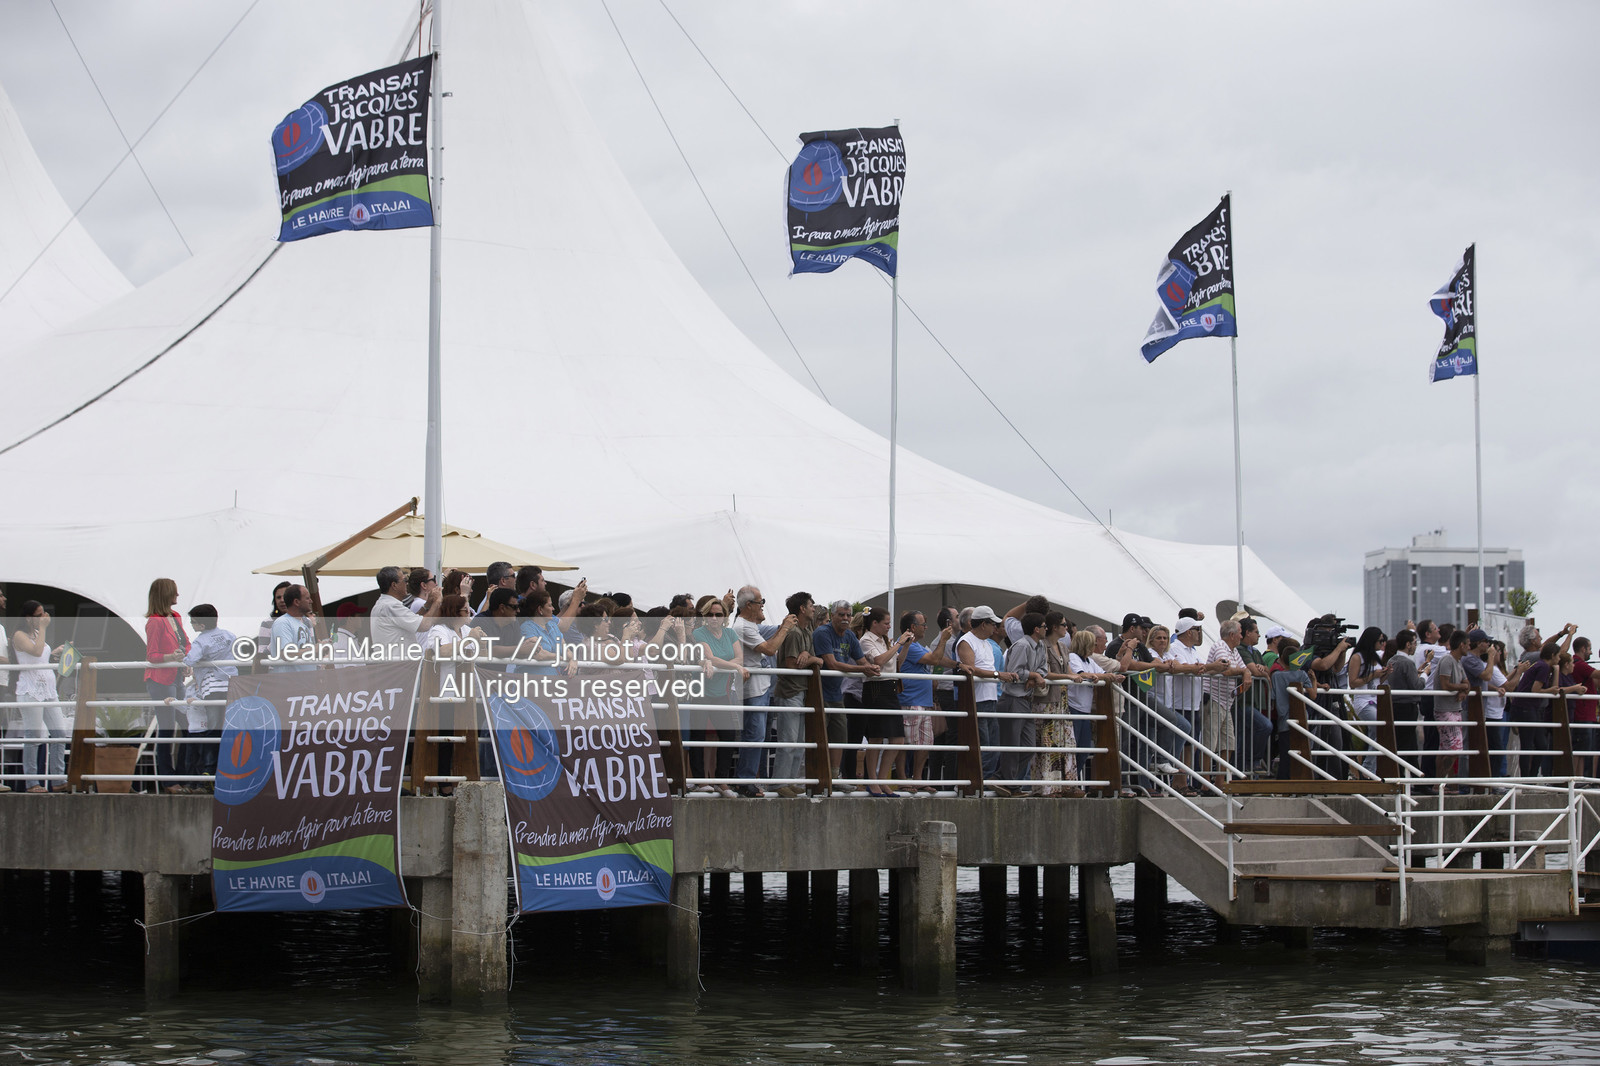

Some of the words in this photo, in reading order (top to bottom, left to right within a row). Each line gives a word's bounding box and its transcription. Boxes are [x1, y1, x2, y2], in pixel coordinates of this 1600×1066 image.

[323, 70, 424, 104] TRANSAT
[319, 112, 423, 156] VABRE
[290, 186, 313, 207] para
[314, 181, 323, 193] o
[390, 159, 399, 171] a
[399, 150, 425, 169] terra
[840, 176, 903, 208] VABR
[291, 216, 307, 230] LE
[308, 206, 345, 224] HAVRE
[370, 199, 411, 214] ITAJAI
[792, 225, 809, 239] Ir
[807, 230, 832, 243] para
[833, 229, 842, 240] o
[1187, 288, 1207, 308] Agir
[286, 687, 403, 718] TRANSAT
[551, 697, 645, 721] TRANSAT
[270, 746, 395, 800] VABRE
[556, 753, 668, 803] VABRE
[212, 825, 254, 851] Prendre
[257, 826, 268, 850] la
[269, 829, 293, 848] mer,
[293, 815, 324, 850] Agir
[321, 814, 352, 841] pour
[349, 802, 361, 827] la
[362, 801, 393, 824] terre
[514, 821, 557, 847] Prendre
[558, 823, 569, 847] la
[569, 826, 590, 843] mer,
[634, 807, 645, 831] la
[645, 807, 673, 829] terre
[228, 877, 247, 890] LE
[250, 875, 296, 889] HAVRE
[326, 870, 372, 886] ITAJAI
[535, 873, 551, 886] LE
[554, 872, 593, 886] HAVRE
